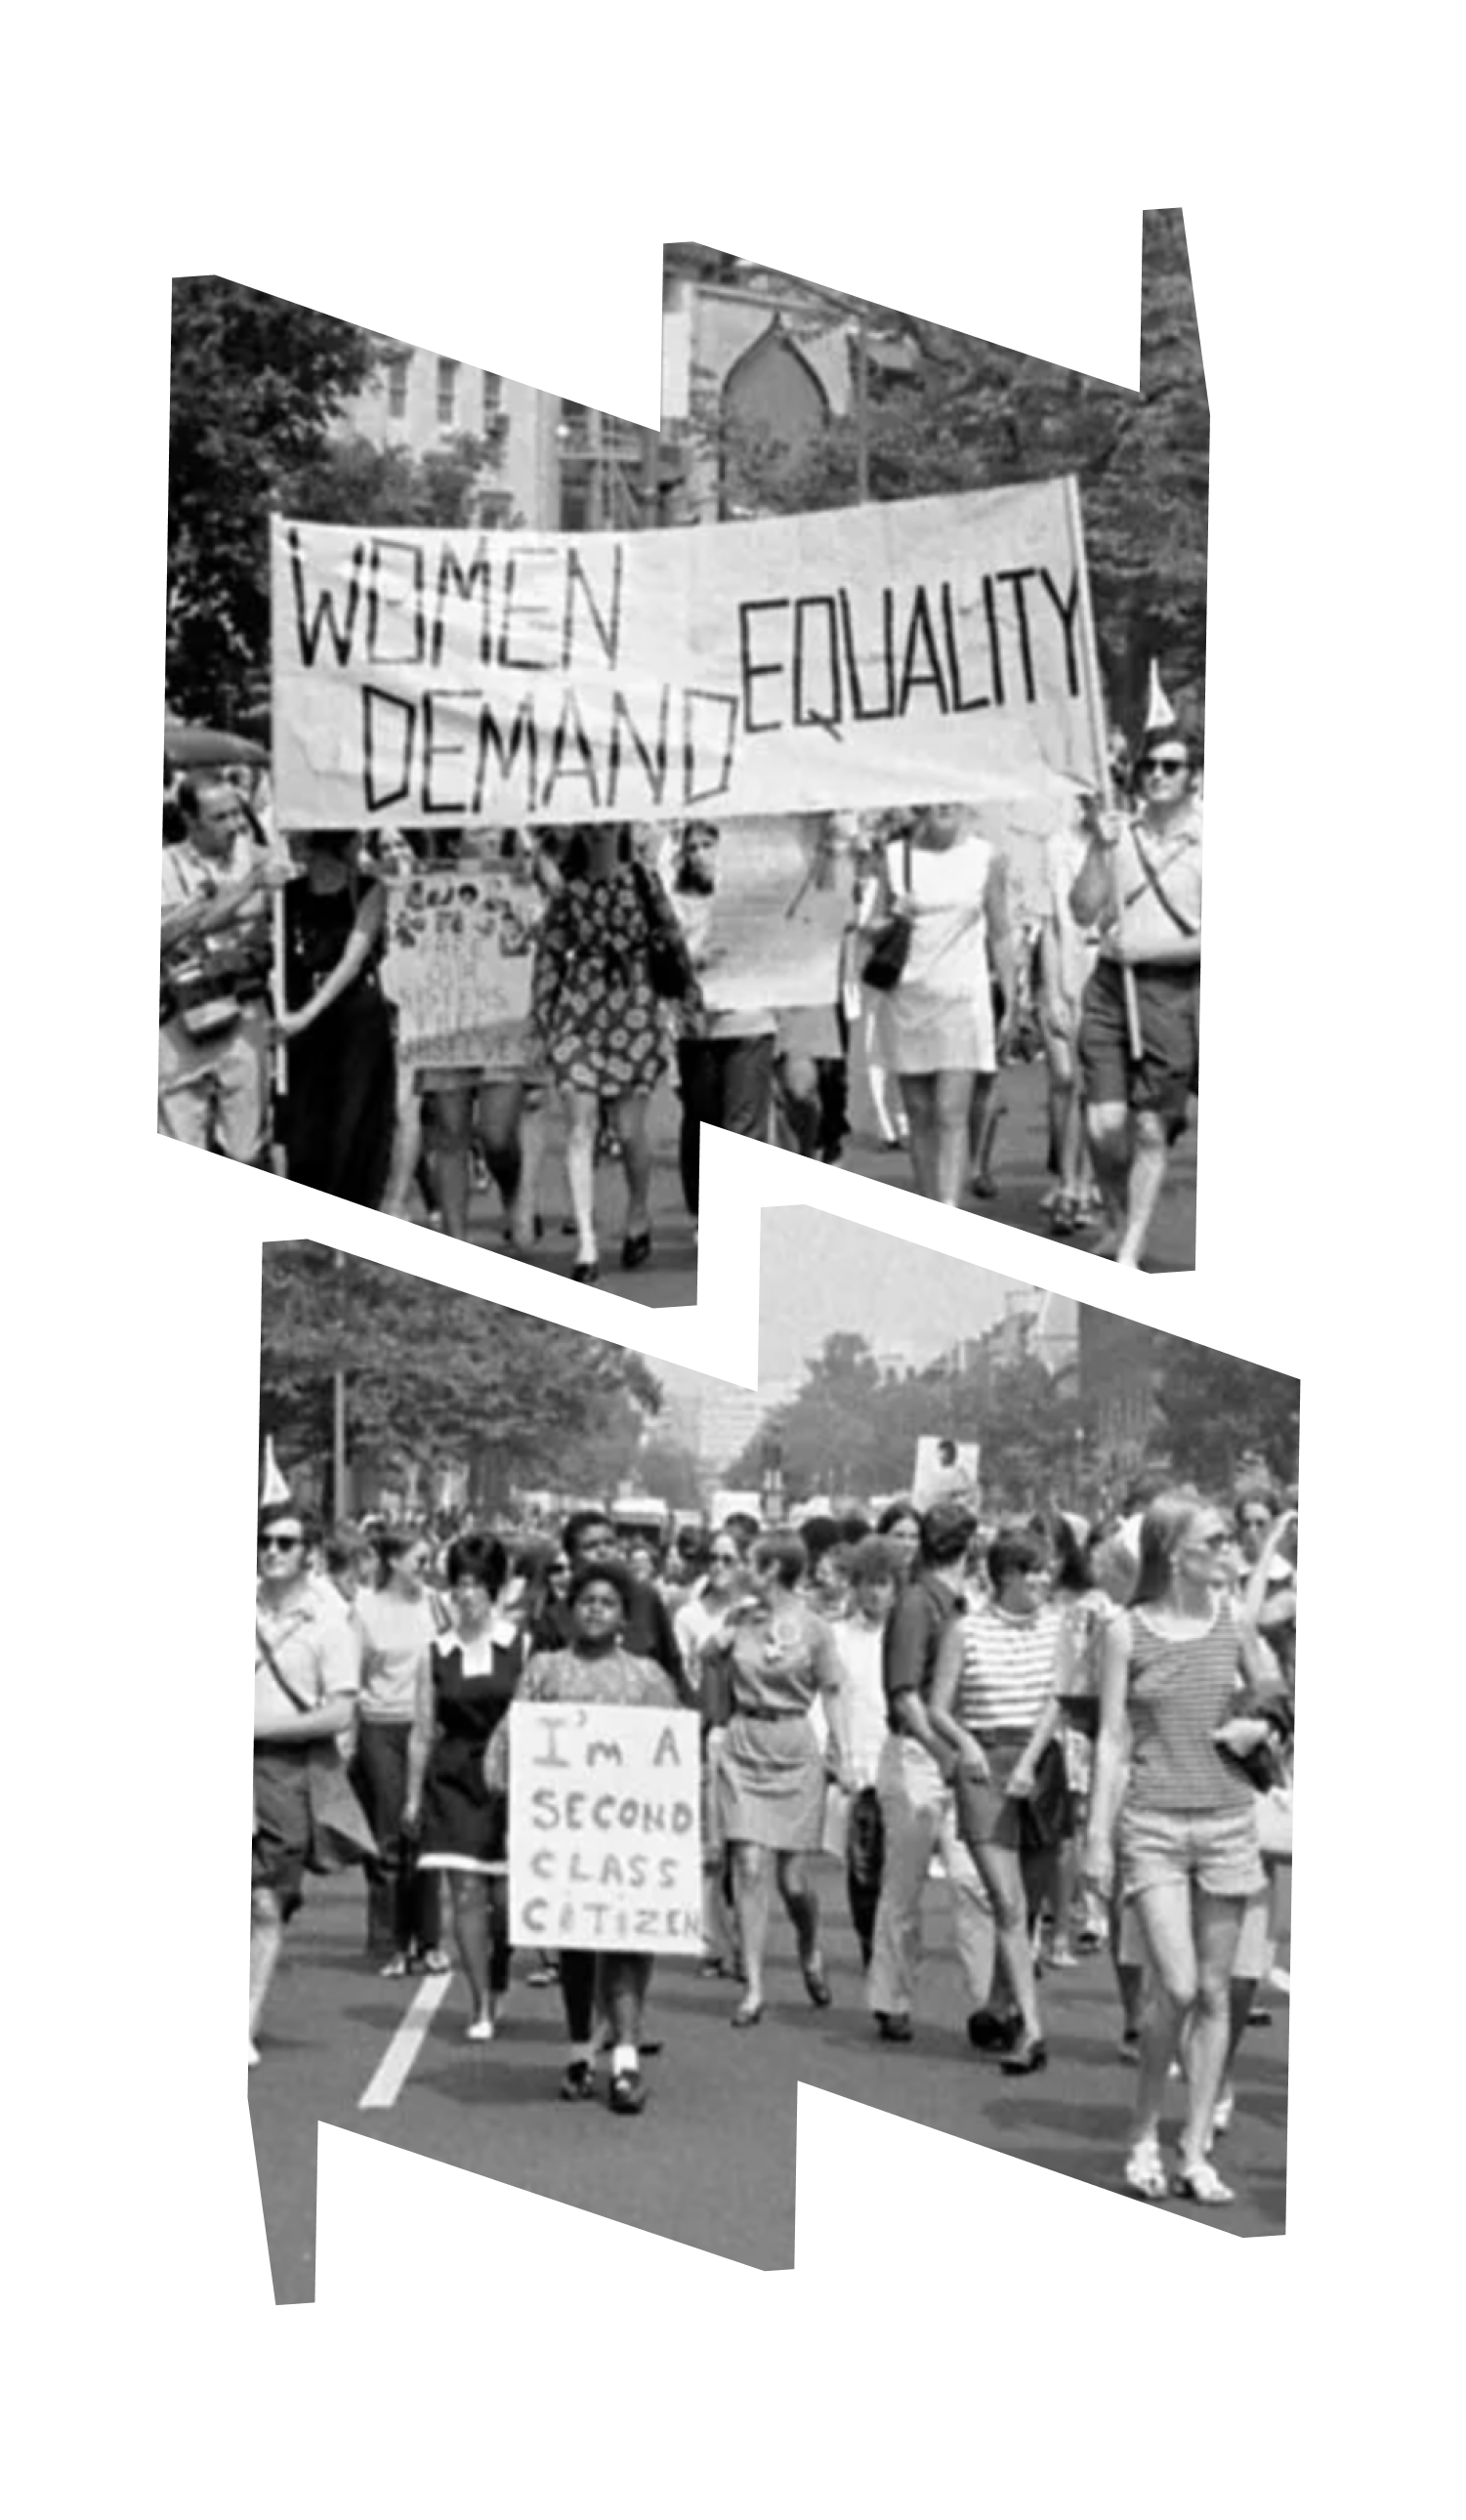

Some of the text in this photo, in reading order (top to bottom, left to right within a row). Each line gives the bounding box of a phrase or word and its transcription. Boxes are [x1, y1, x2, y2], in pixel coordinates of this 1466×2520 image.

[289, 525, 622, 672] WOMEN
[739, 566, 1080, 742] EQUALITY
[360, 684, 739, 814] DEMAND
[652, 1725, 680, 1768] A
[531, 1788, 692, 1836] SECOND
[530, 1848, 678, 1889] CLASS
